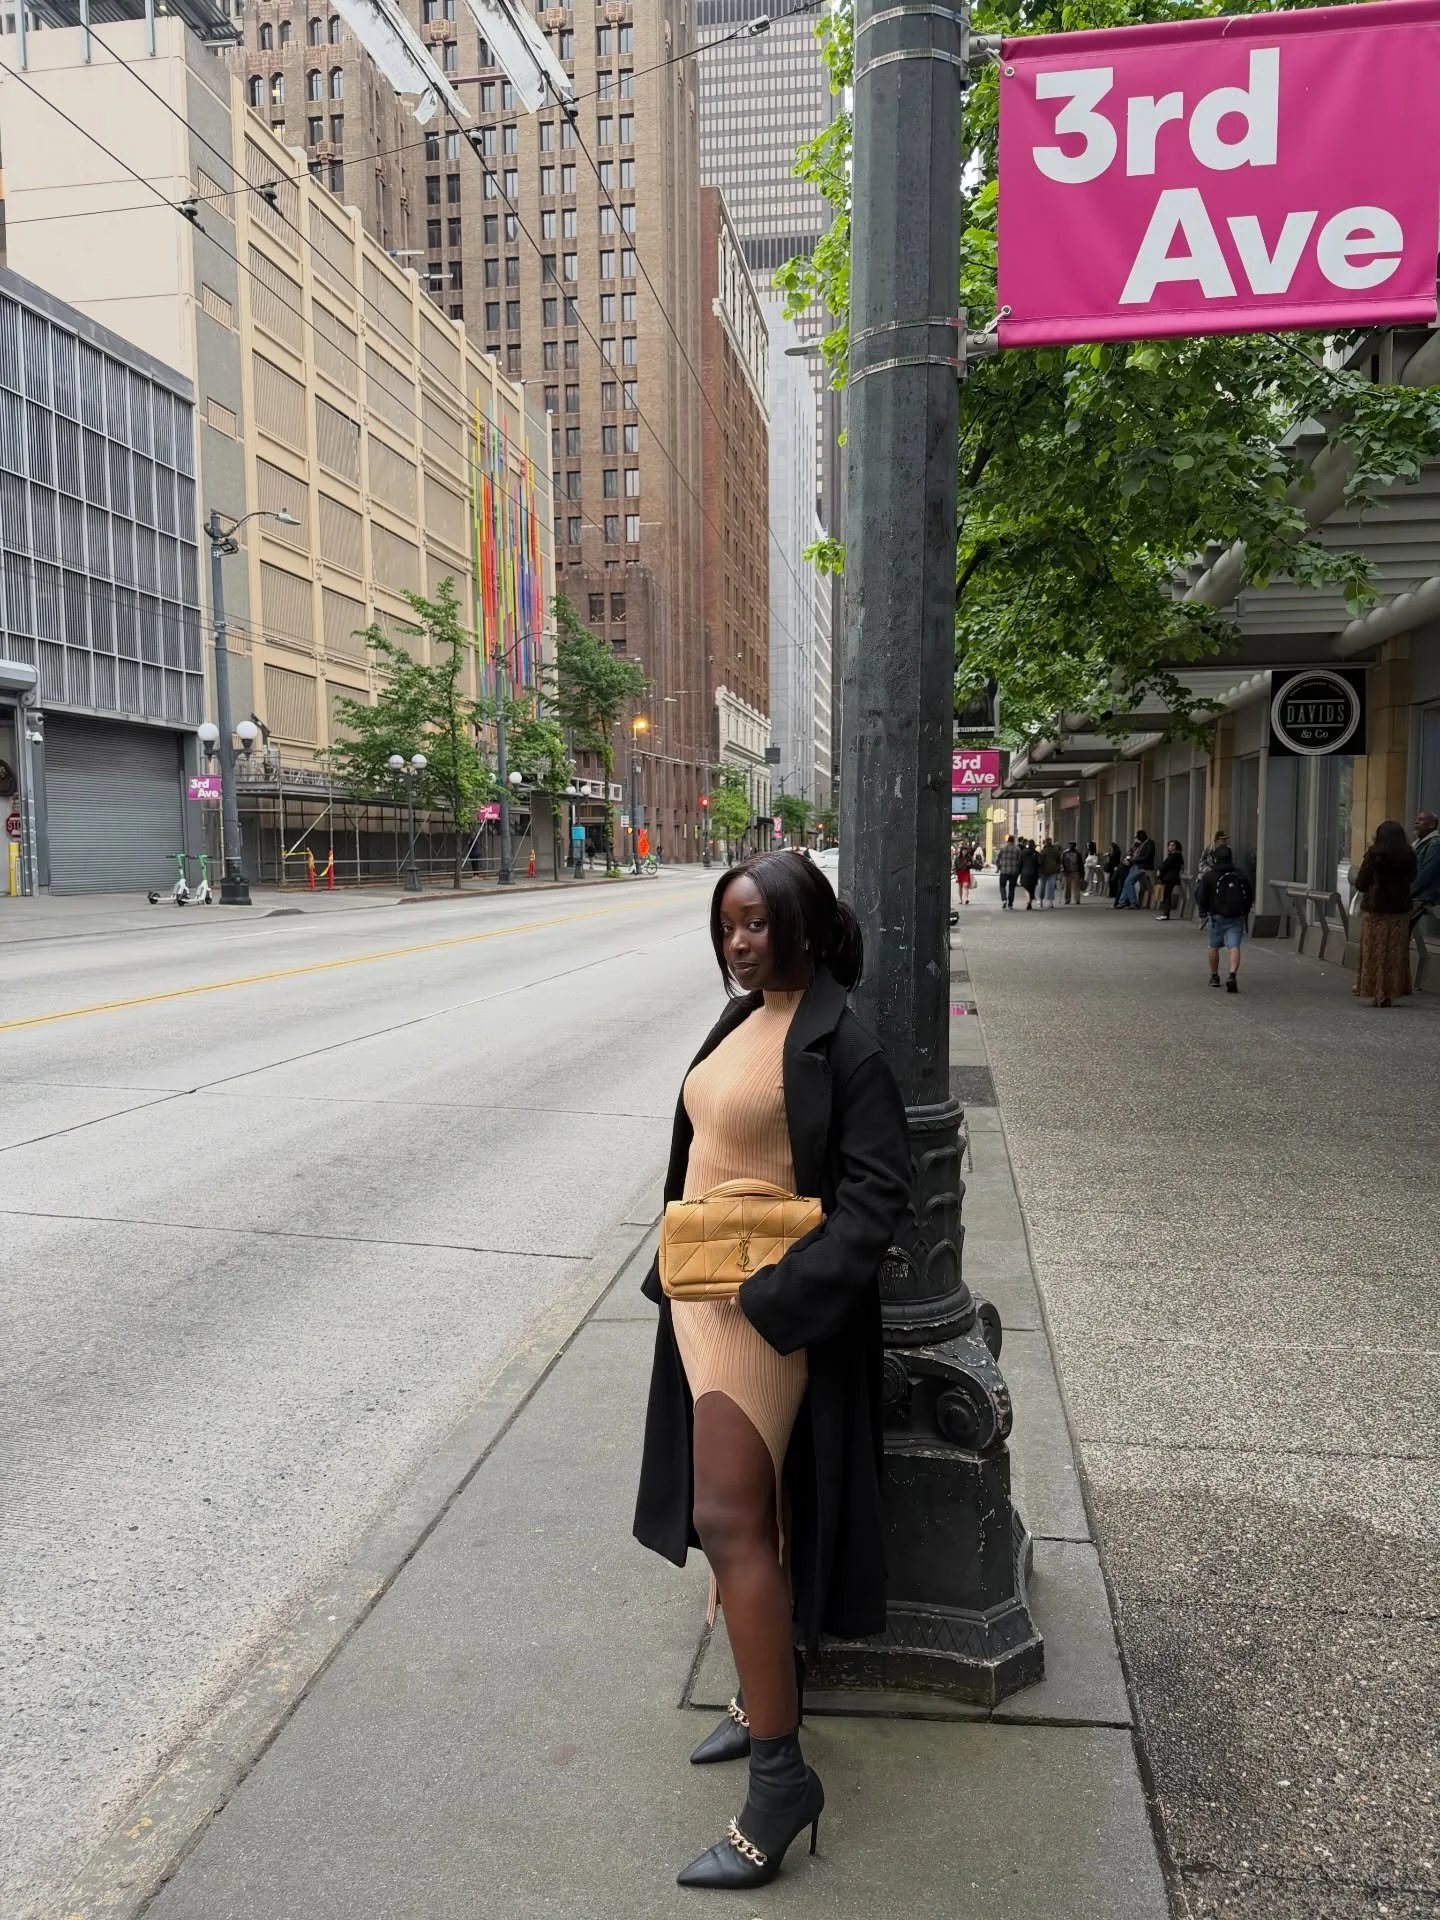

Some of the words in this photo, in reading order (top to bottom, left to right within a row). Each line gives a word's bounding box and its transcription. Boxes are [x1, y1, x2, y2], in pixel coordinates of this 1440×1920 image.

[1032, 47, 1281, 184] 3rd
[1118, 187, 1404, 305] Ave
[1286, 704, 1345, 723] DAVIDS
[1314, 728, 1329, 738] Co
[952, 755, 981, 770] 3rd
[190, 778, 210, 789] 3rd
[961, 770, 996, 785] Ave
[197, 788, 219, 798] Ave
